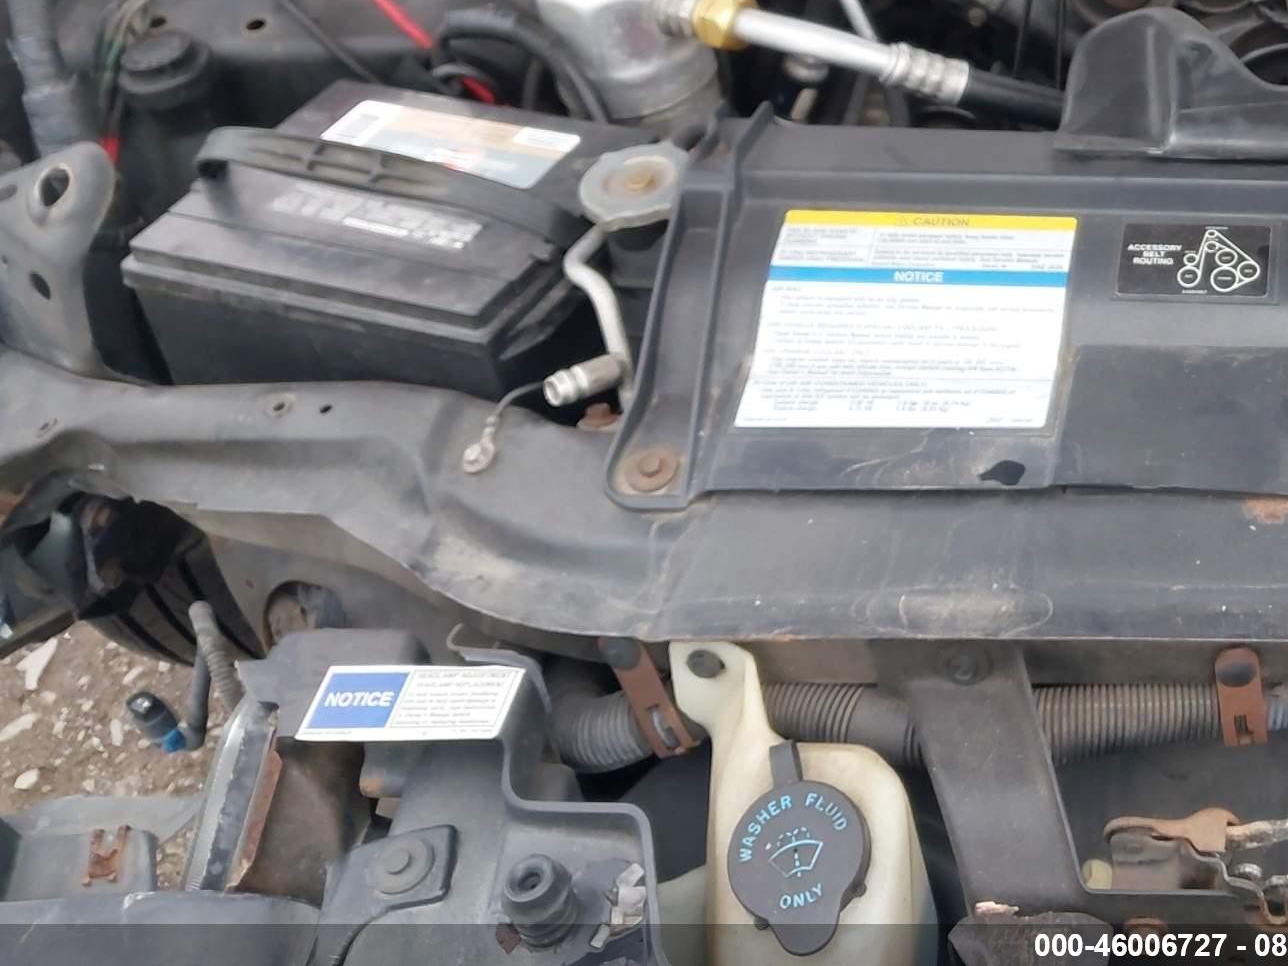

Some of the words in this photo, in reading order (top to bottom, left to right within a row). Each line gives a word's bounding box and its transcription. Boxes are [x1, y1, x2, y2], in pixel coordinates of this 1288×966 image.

[912, 217, 970, 227] CAUTION
[1133, 257, 1174, 265] ROUTING
[893, 270, 944, 283] NOTICE
[324, 691, 395, 708] NOTICE
[739, 795, 792, 862] WASHER
[805, 793, 848, 830] FLUID
[779, 884, 823, 909] ONLY
